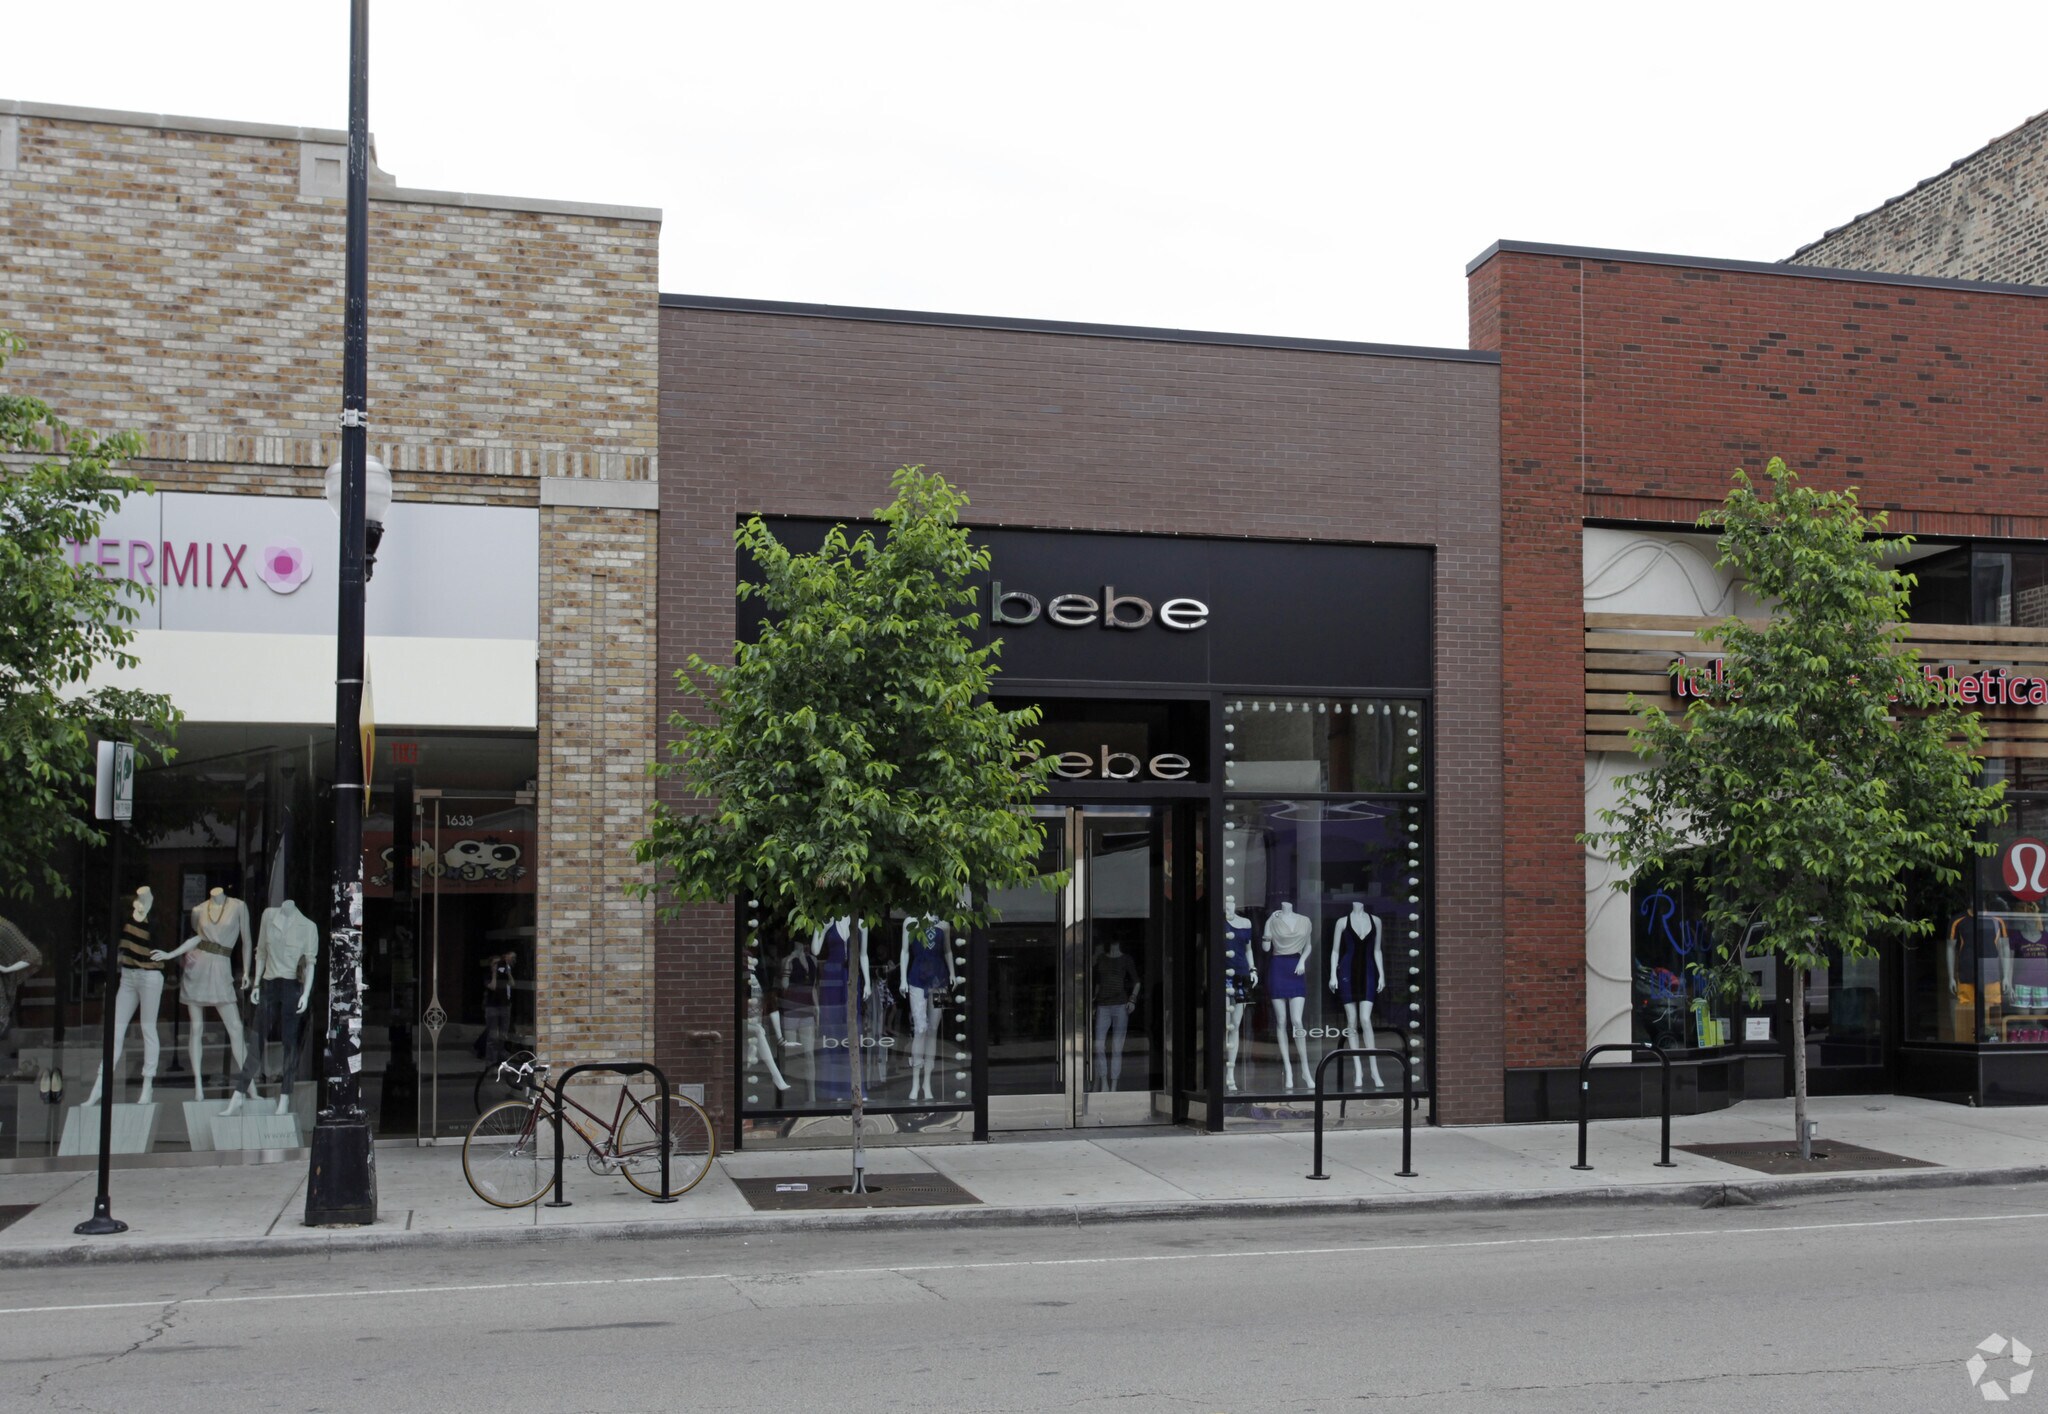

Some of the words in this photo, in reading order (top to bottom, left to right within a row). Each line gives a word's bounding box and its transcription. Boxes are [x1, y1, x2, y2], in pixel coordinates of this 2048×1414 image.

[991, 580, 1210, 630] bebe
[1888, 664, 2048, 706] hletica
[1009, 744, 1191, 780] ebe
[445, 814, 474, 827] 1633
[1292, 1024, 1357, 1039] bebe
